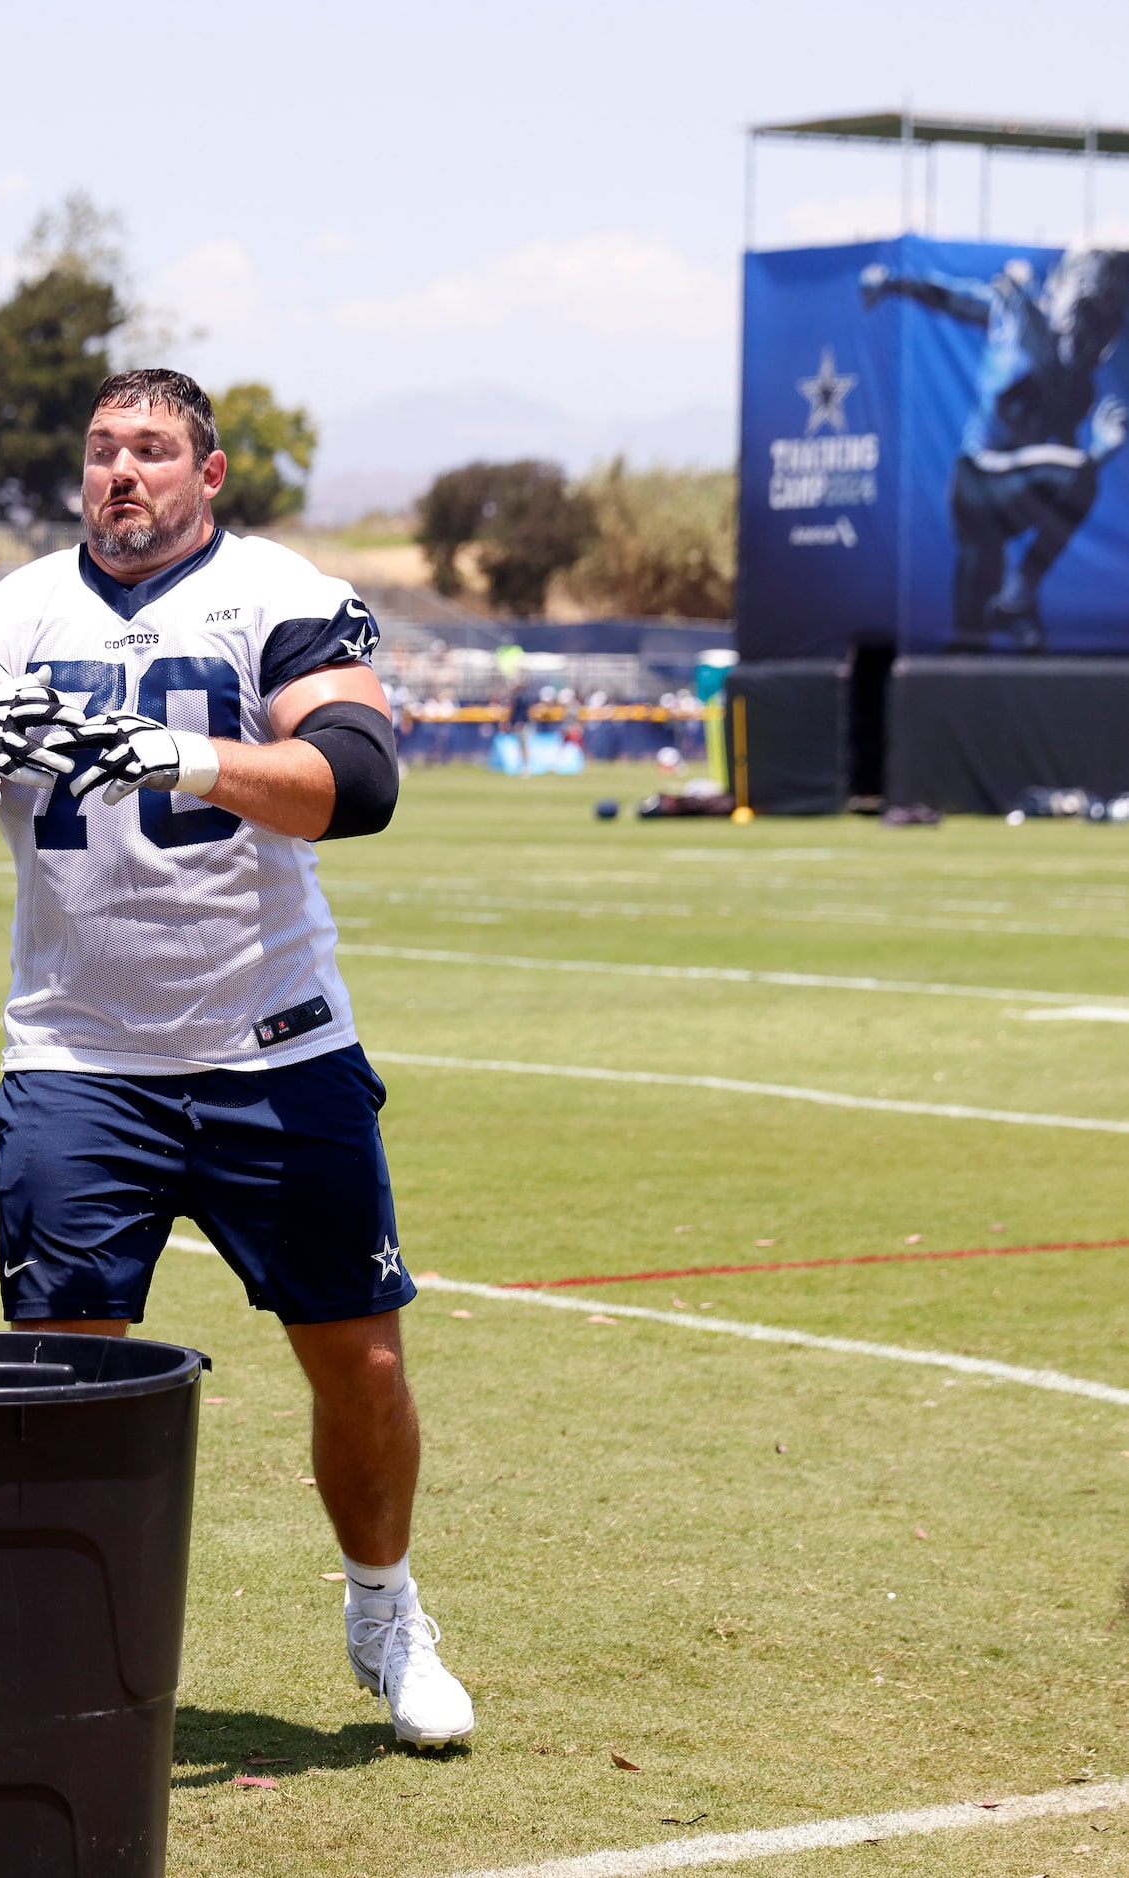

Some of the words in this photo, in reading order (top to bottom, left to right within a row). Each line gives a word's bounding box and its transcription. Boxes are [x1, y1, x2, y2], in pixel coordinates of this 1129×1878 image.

[205, 608, 241, 624] AT&T
[104, 633, 160, 649] COWBOYS
[26, 656, 242, 850] 70
